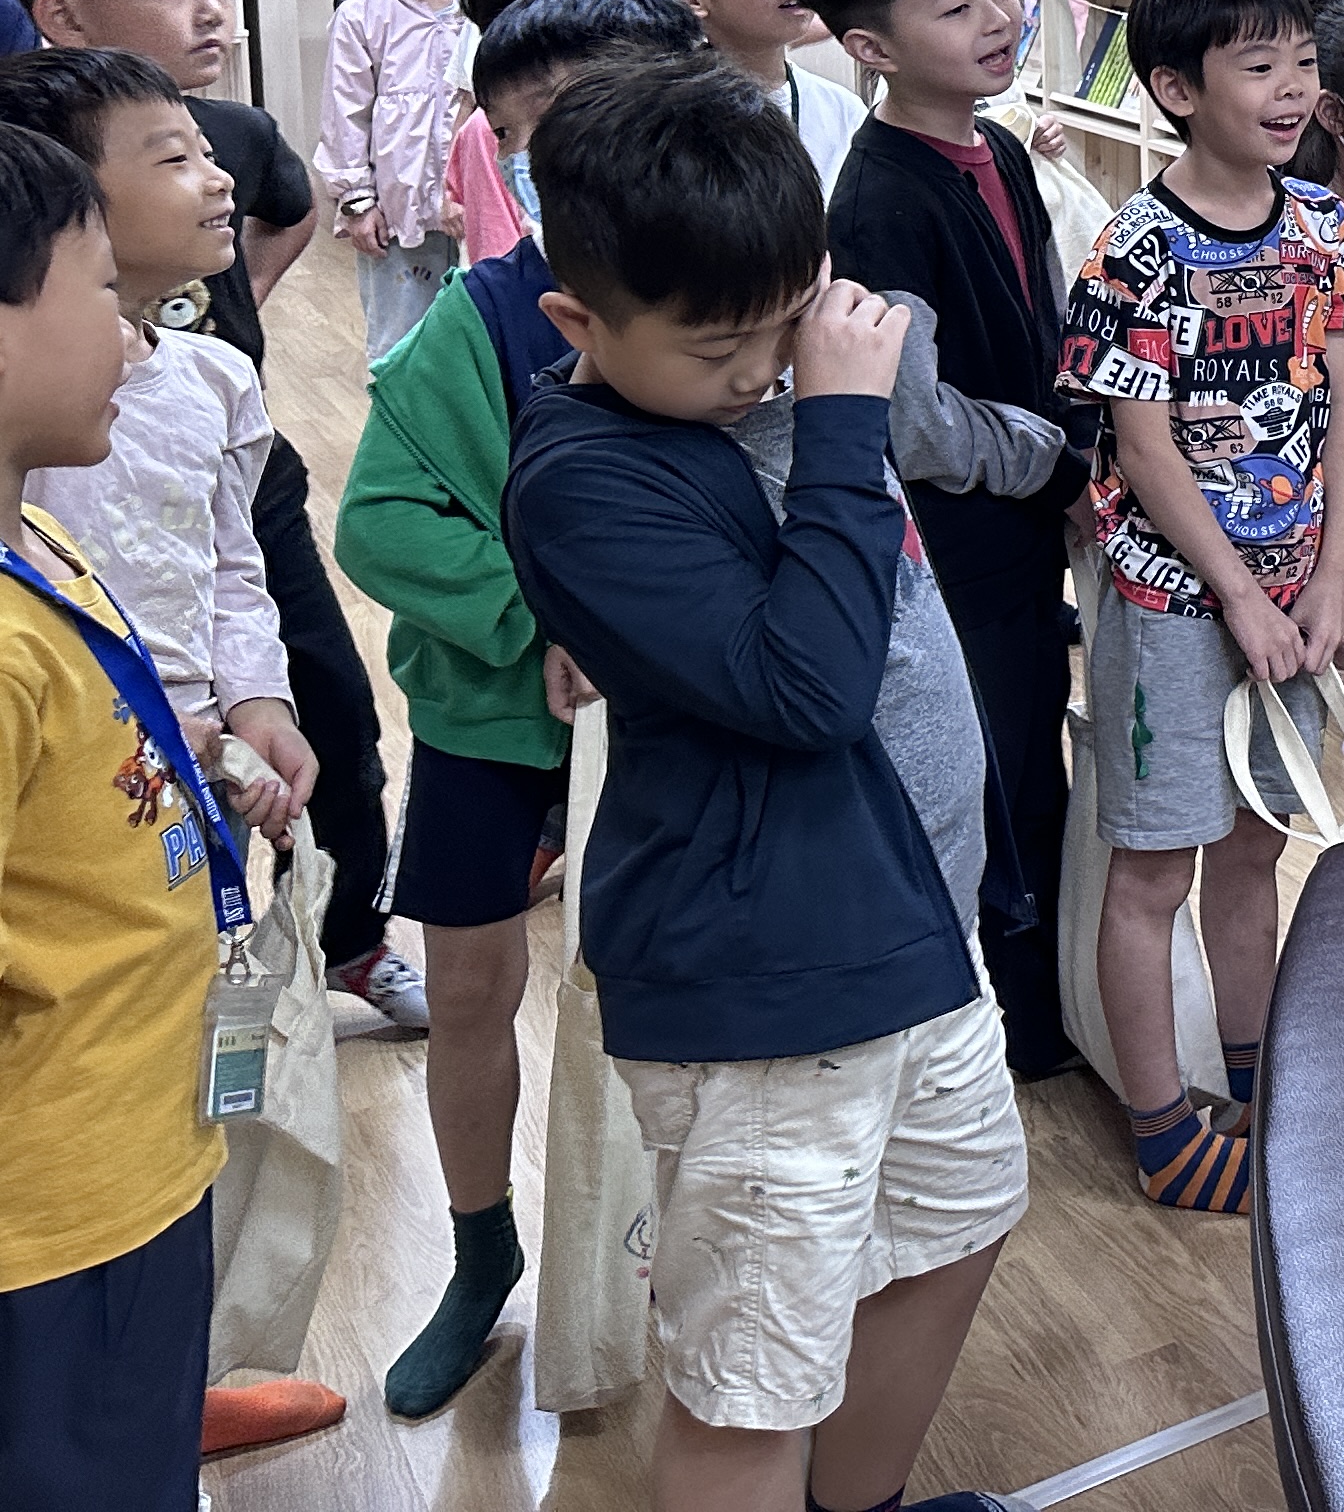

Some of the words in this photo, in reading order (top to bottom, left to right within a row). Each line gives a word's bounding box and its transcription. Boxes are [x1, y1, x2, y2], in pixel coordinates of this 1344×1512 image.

[1191, 245, 1247, 261] CHOOSE
[1205, 306, 1293, 357] LOVE
[1104, 357, 1163, 402] LIFE
[1193, 358, 1279, 383] ROYALS
[1225, 518, 1276, 538] CHOOSE
